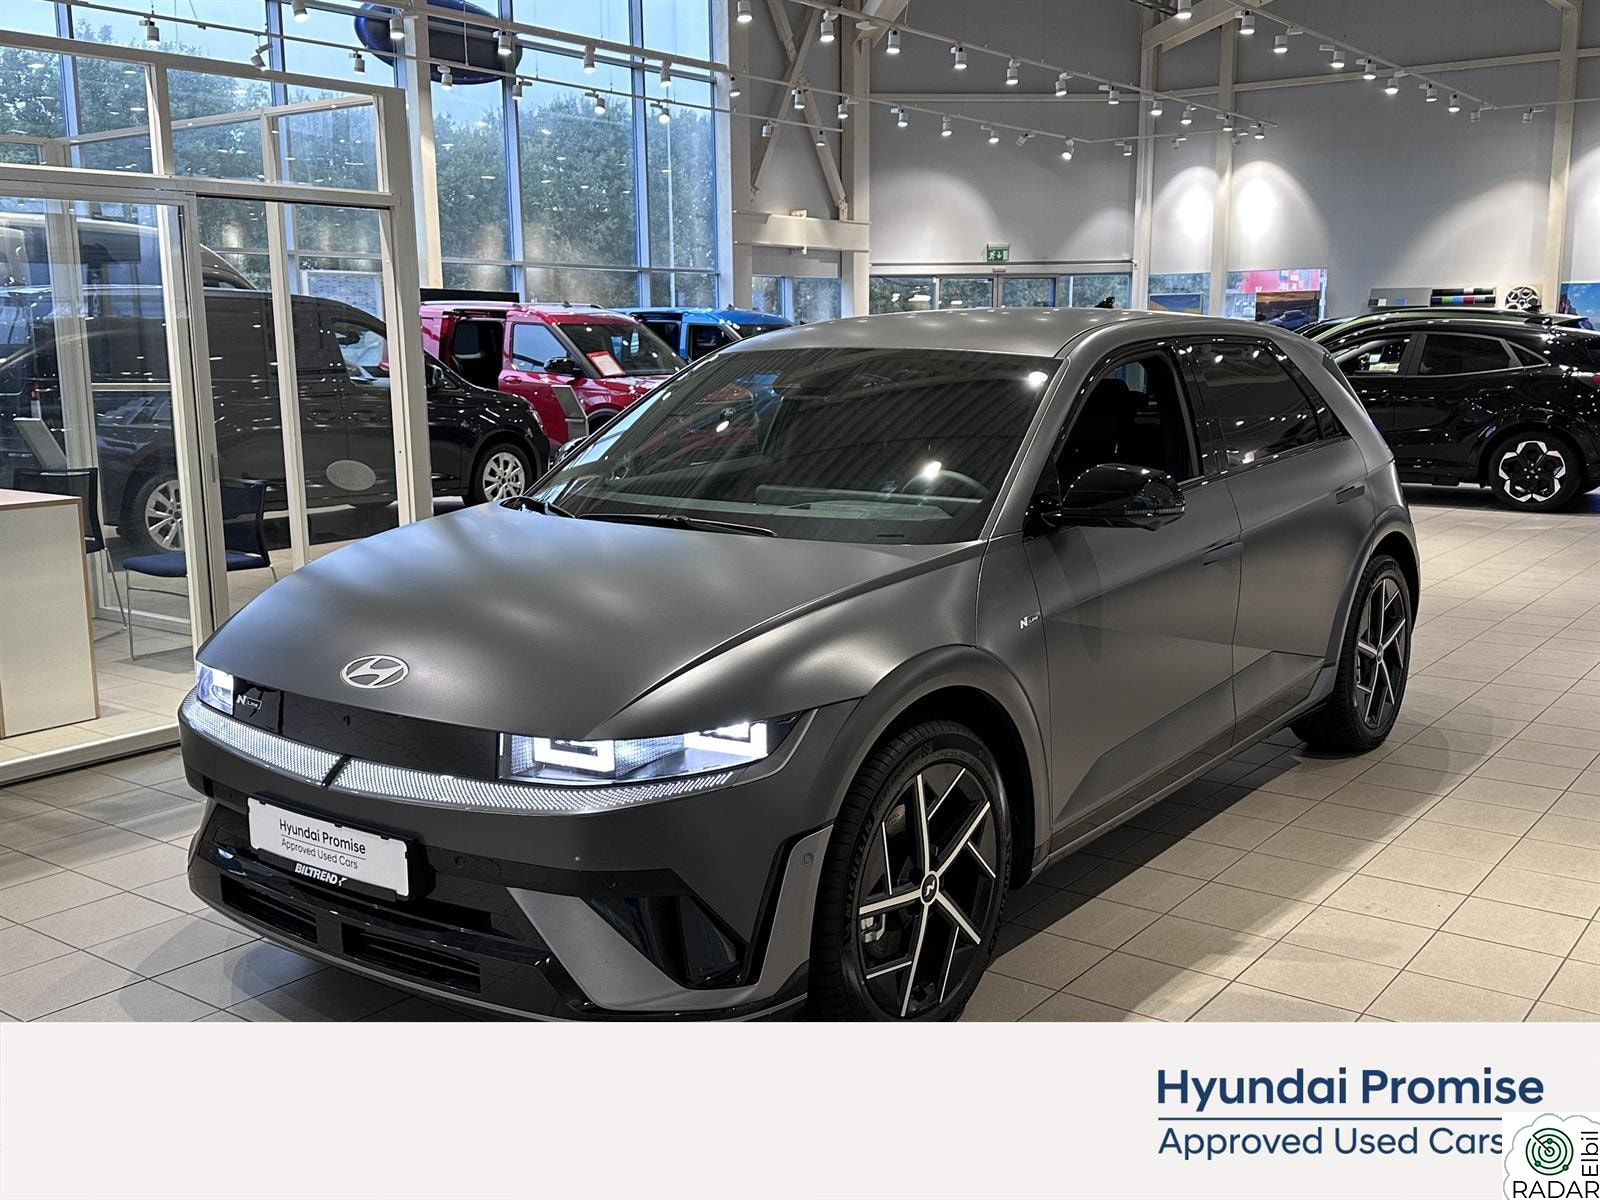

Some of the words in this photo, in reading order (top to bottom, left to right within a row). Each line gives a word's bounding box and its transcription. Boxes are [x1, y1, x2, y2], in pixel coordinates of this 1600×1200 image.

[1020, 617, 1028, 629] N
[236, 694, 247, 705] N
[279, 818, 320, 843] Hyundai
[322, 831, 366, 855] Promise
[281, 837, 317, 857] Approved
[318, 849, 338, 865] Used
[338, 855, 358, 869] Cars
[295, 863, 338, 884] BILTREND
